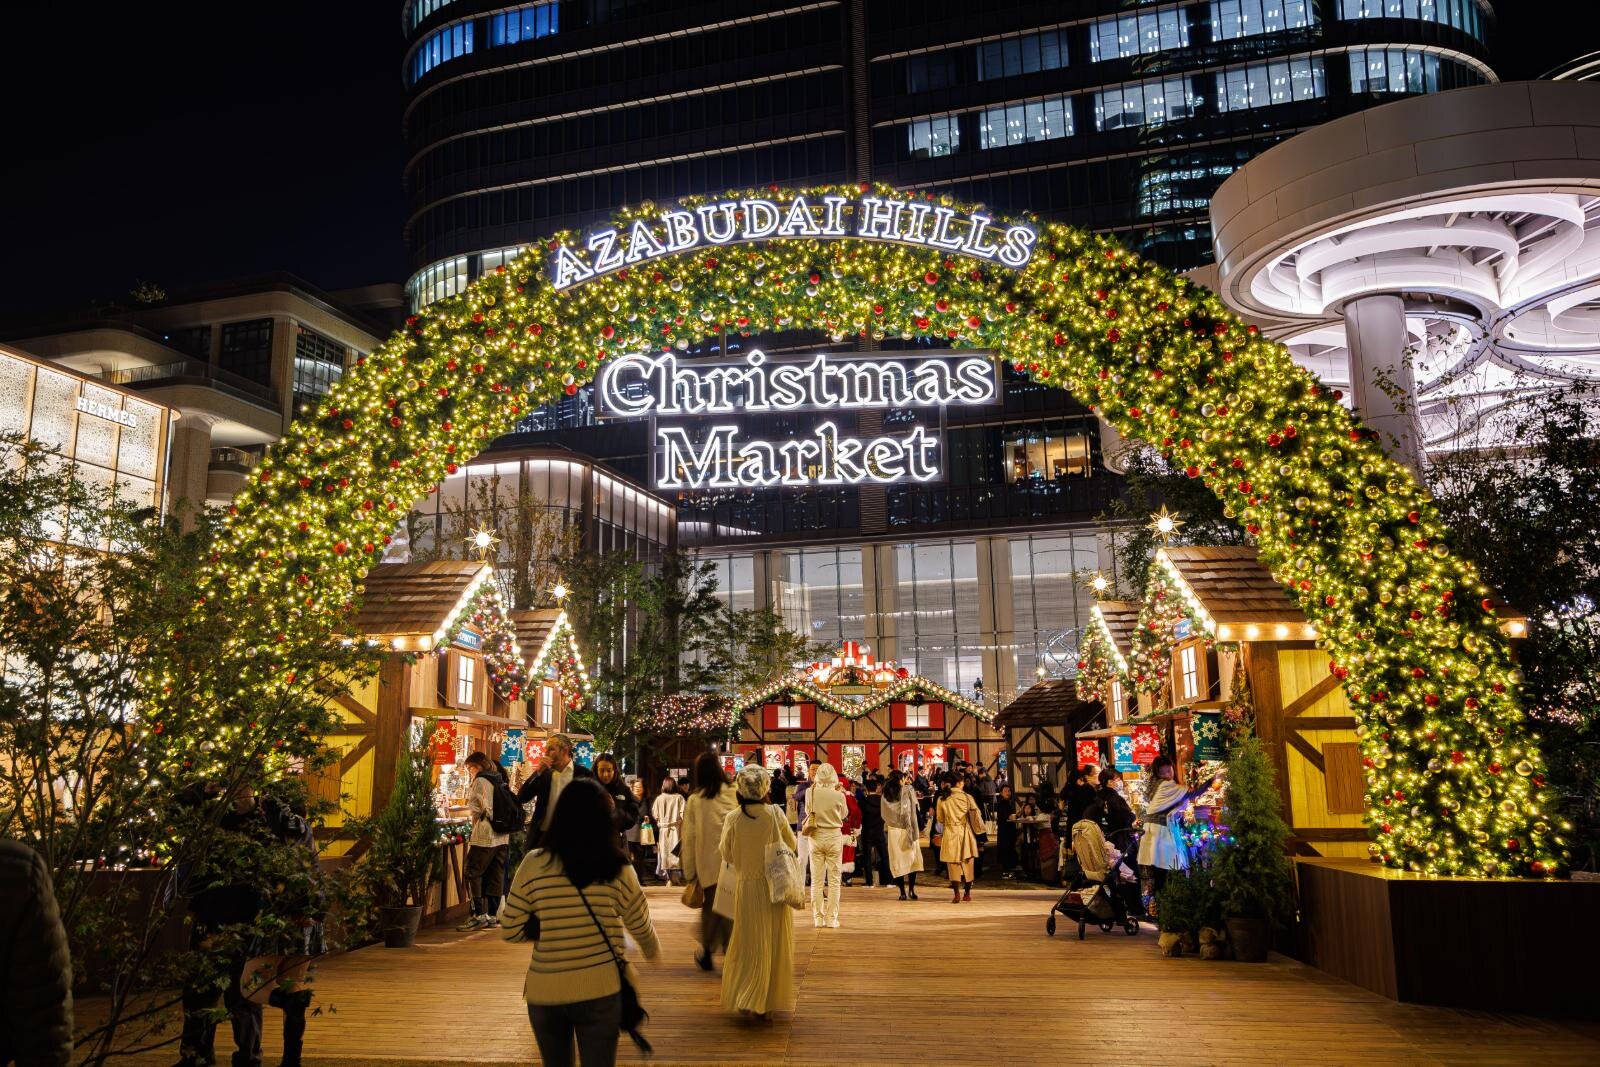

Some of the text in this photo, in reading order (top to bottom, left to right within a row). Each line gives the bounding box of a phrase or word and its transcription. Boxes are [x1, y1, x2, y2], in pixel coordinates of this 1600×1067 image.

[553, 197, 1037, 291] AZABUDAI HILLS
[601, 350, 995, 416] Christmas
[656, 422, 940, 489] Market
